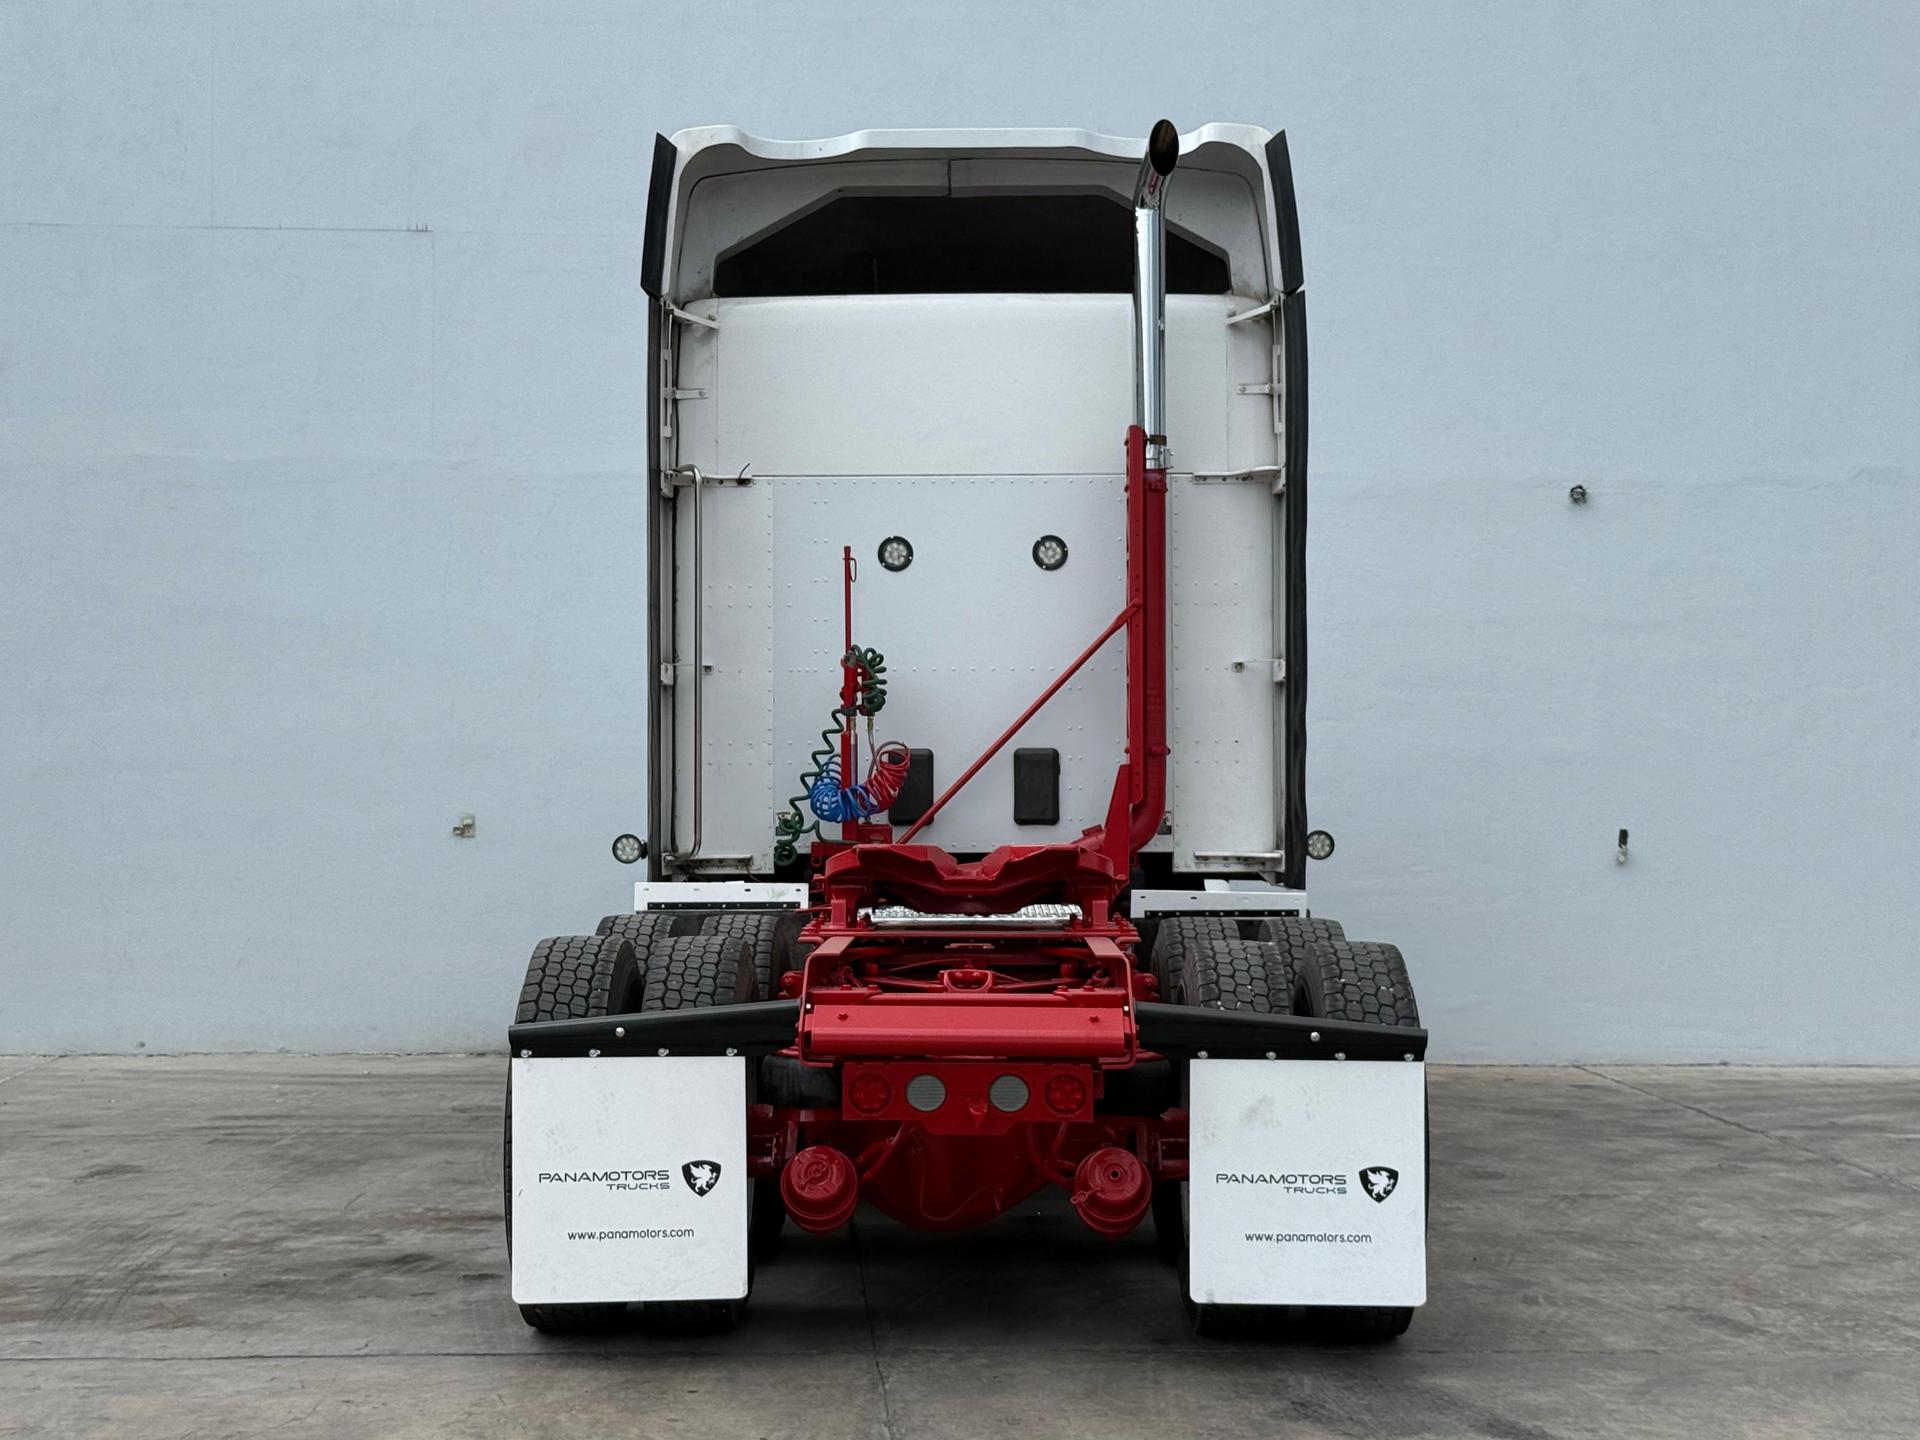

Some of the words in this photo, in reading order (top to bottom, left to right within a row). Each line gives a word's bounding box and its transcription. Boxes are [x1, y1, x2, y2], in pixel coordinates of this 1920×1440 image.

[538, 1170, 670, 1183] PANAMOTORS
[1216, 1173, 1347, 1185] PANAMOTORS
[606, 1183, 670, 1191] TRUCKS
[1283, 1187, 1347, 1195] TRUCKS
[567, 1228, 694, 1241] www.panamotors.com
[1245, 1232, 1372, 1244] www.panamotors.com
